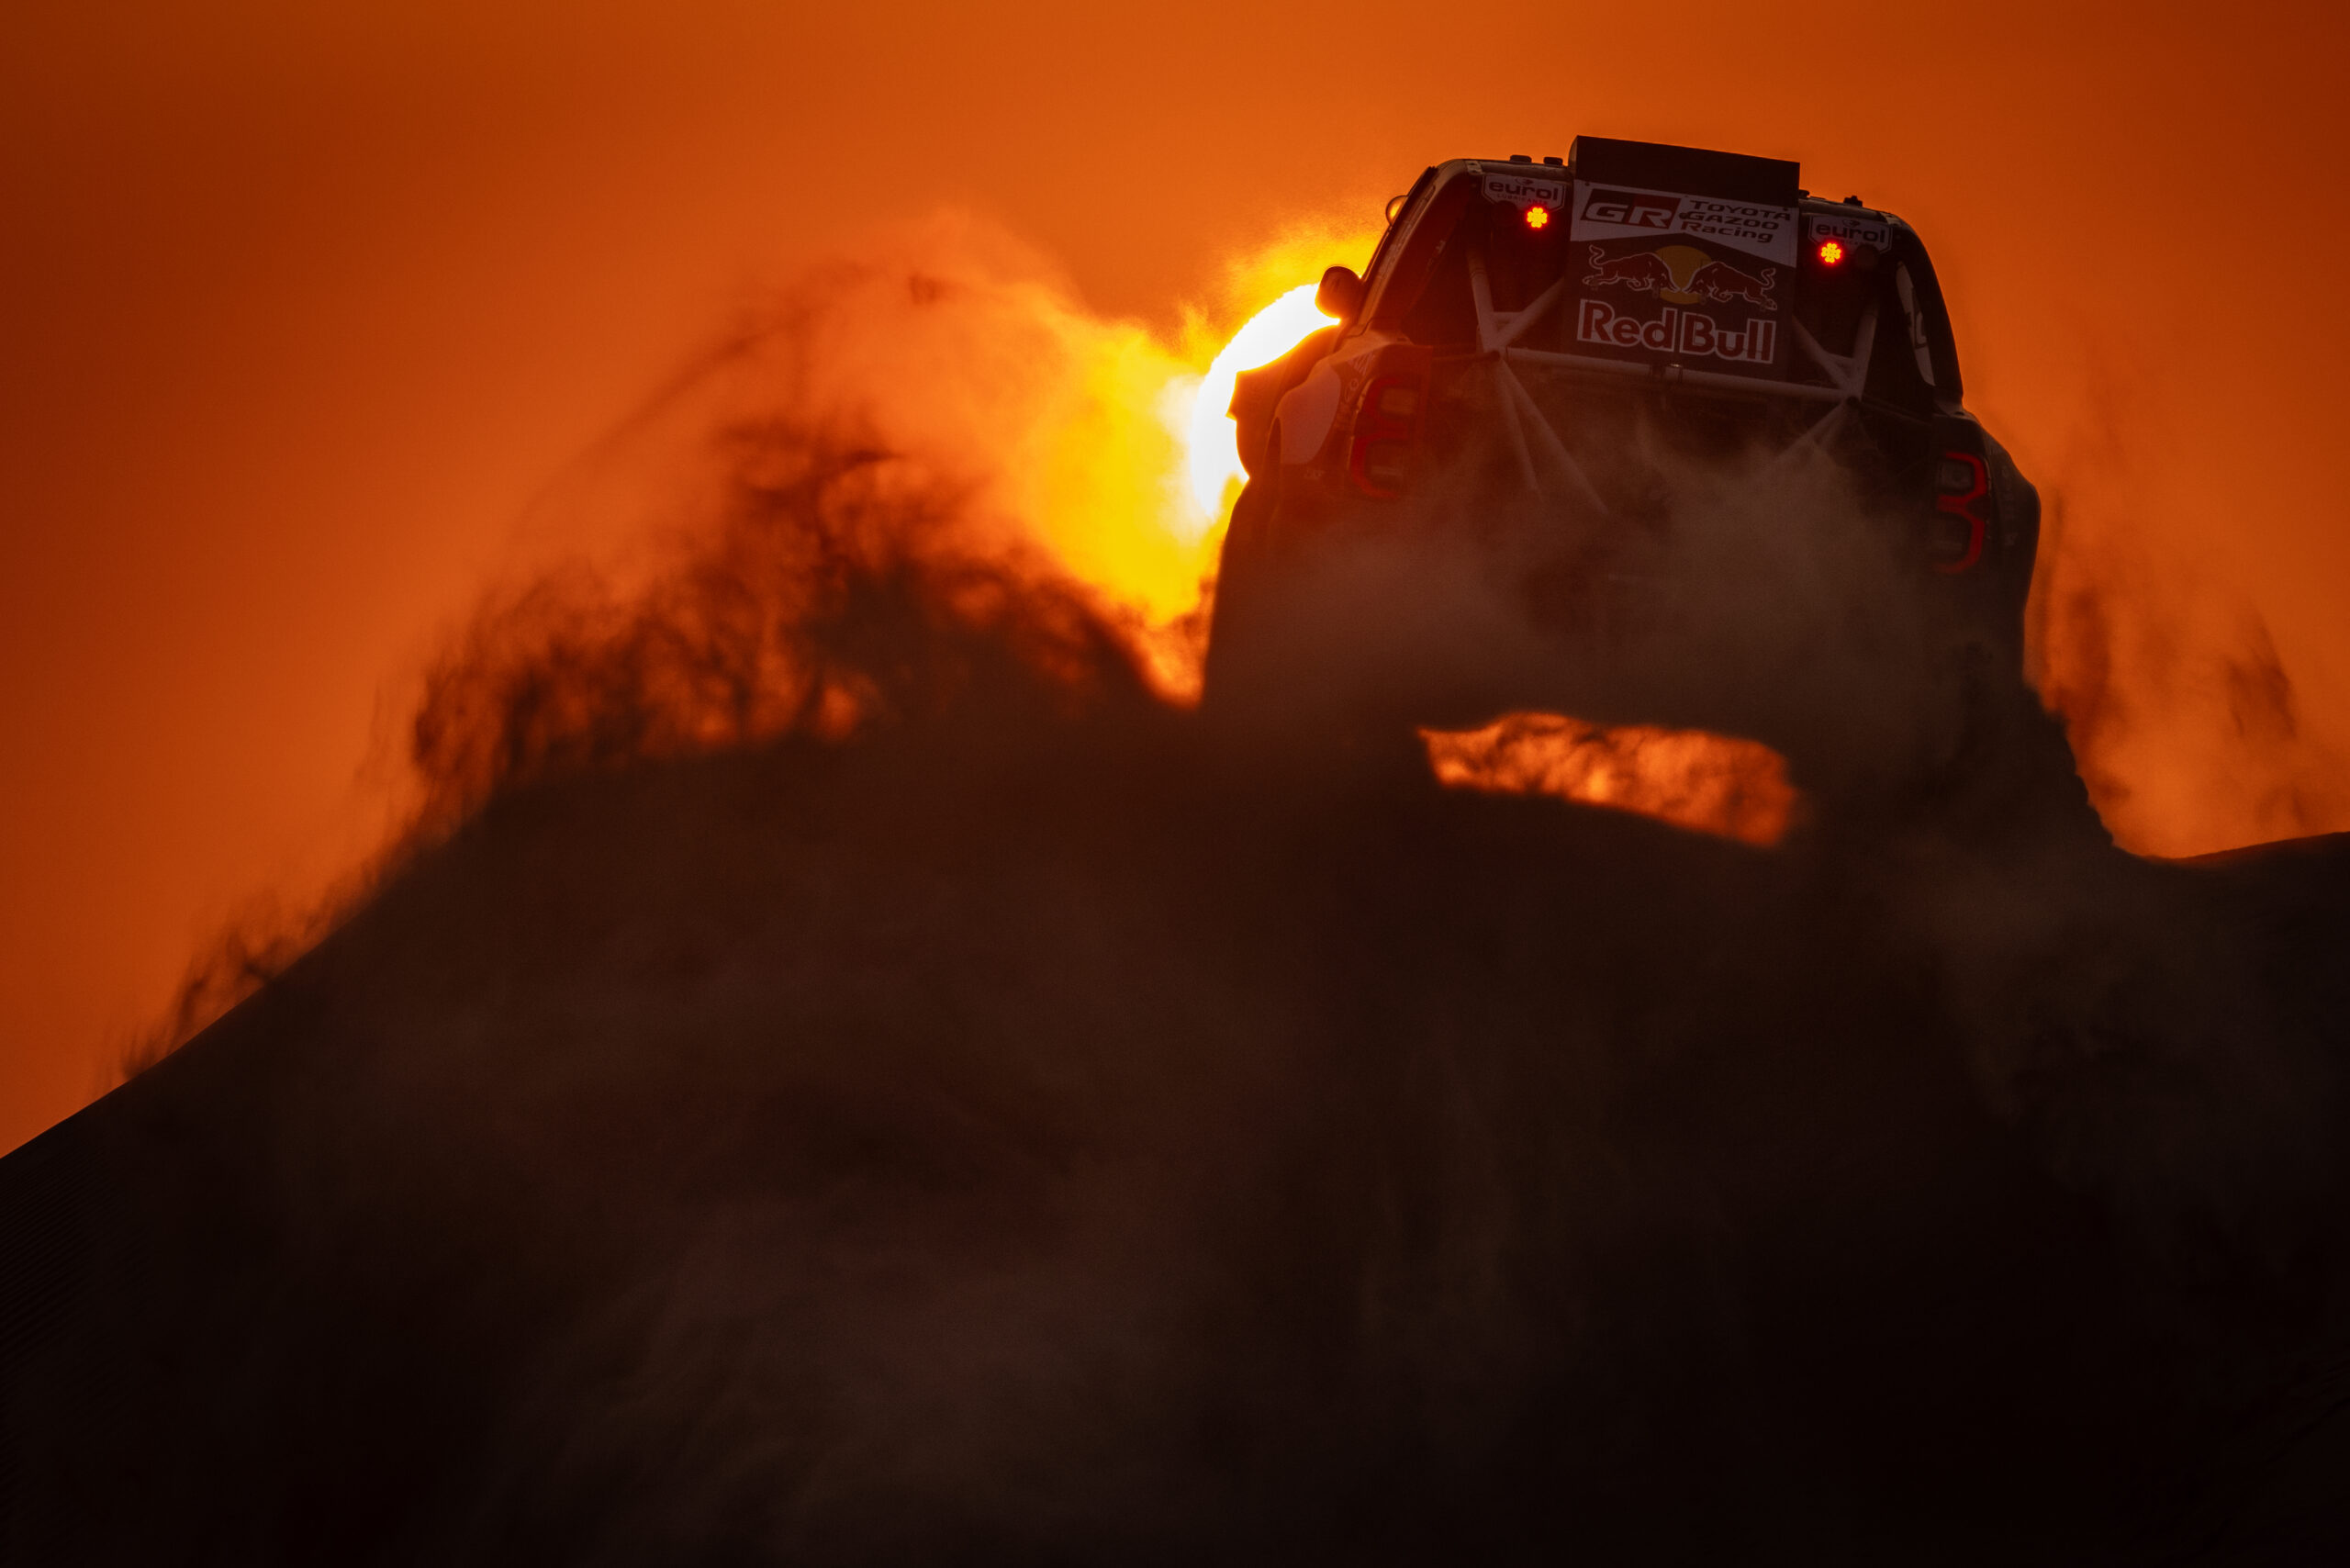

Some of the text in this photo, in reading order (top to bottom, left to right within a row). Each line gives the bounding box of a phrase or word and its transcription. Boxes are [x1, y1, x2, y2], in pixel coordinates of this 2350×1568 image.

[1489, 182, 1559, 200] eurol
[1585, 201, 1673, 229] GR
[1685, 211, 1779, 230] GAZOO
[1690, 200, 1791, 221] TOYOTA
[1681, 221, 1774, 244] Racing
[1816, 224, 1886, 243] eurol
